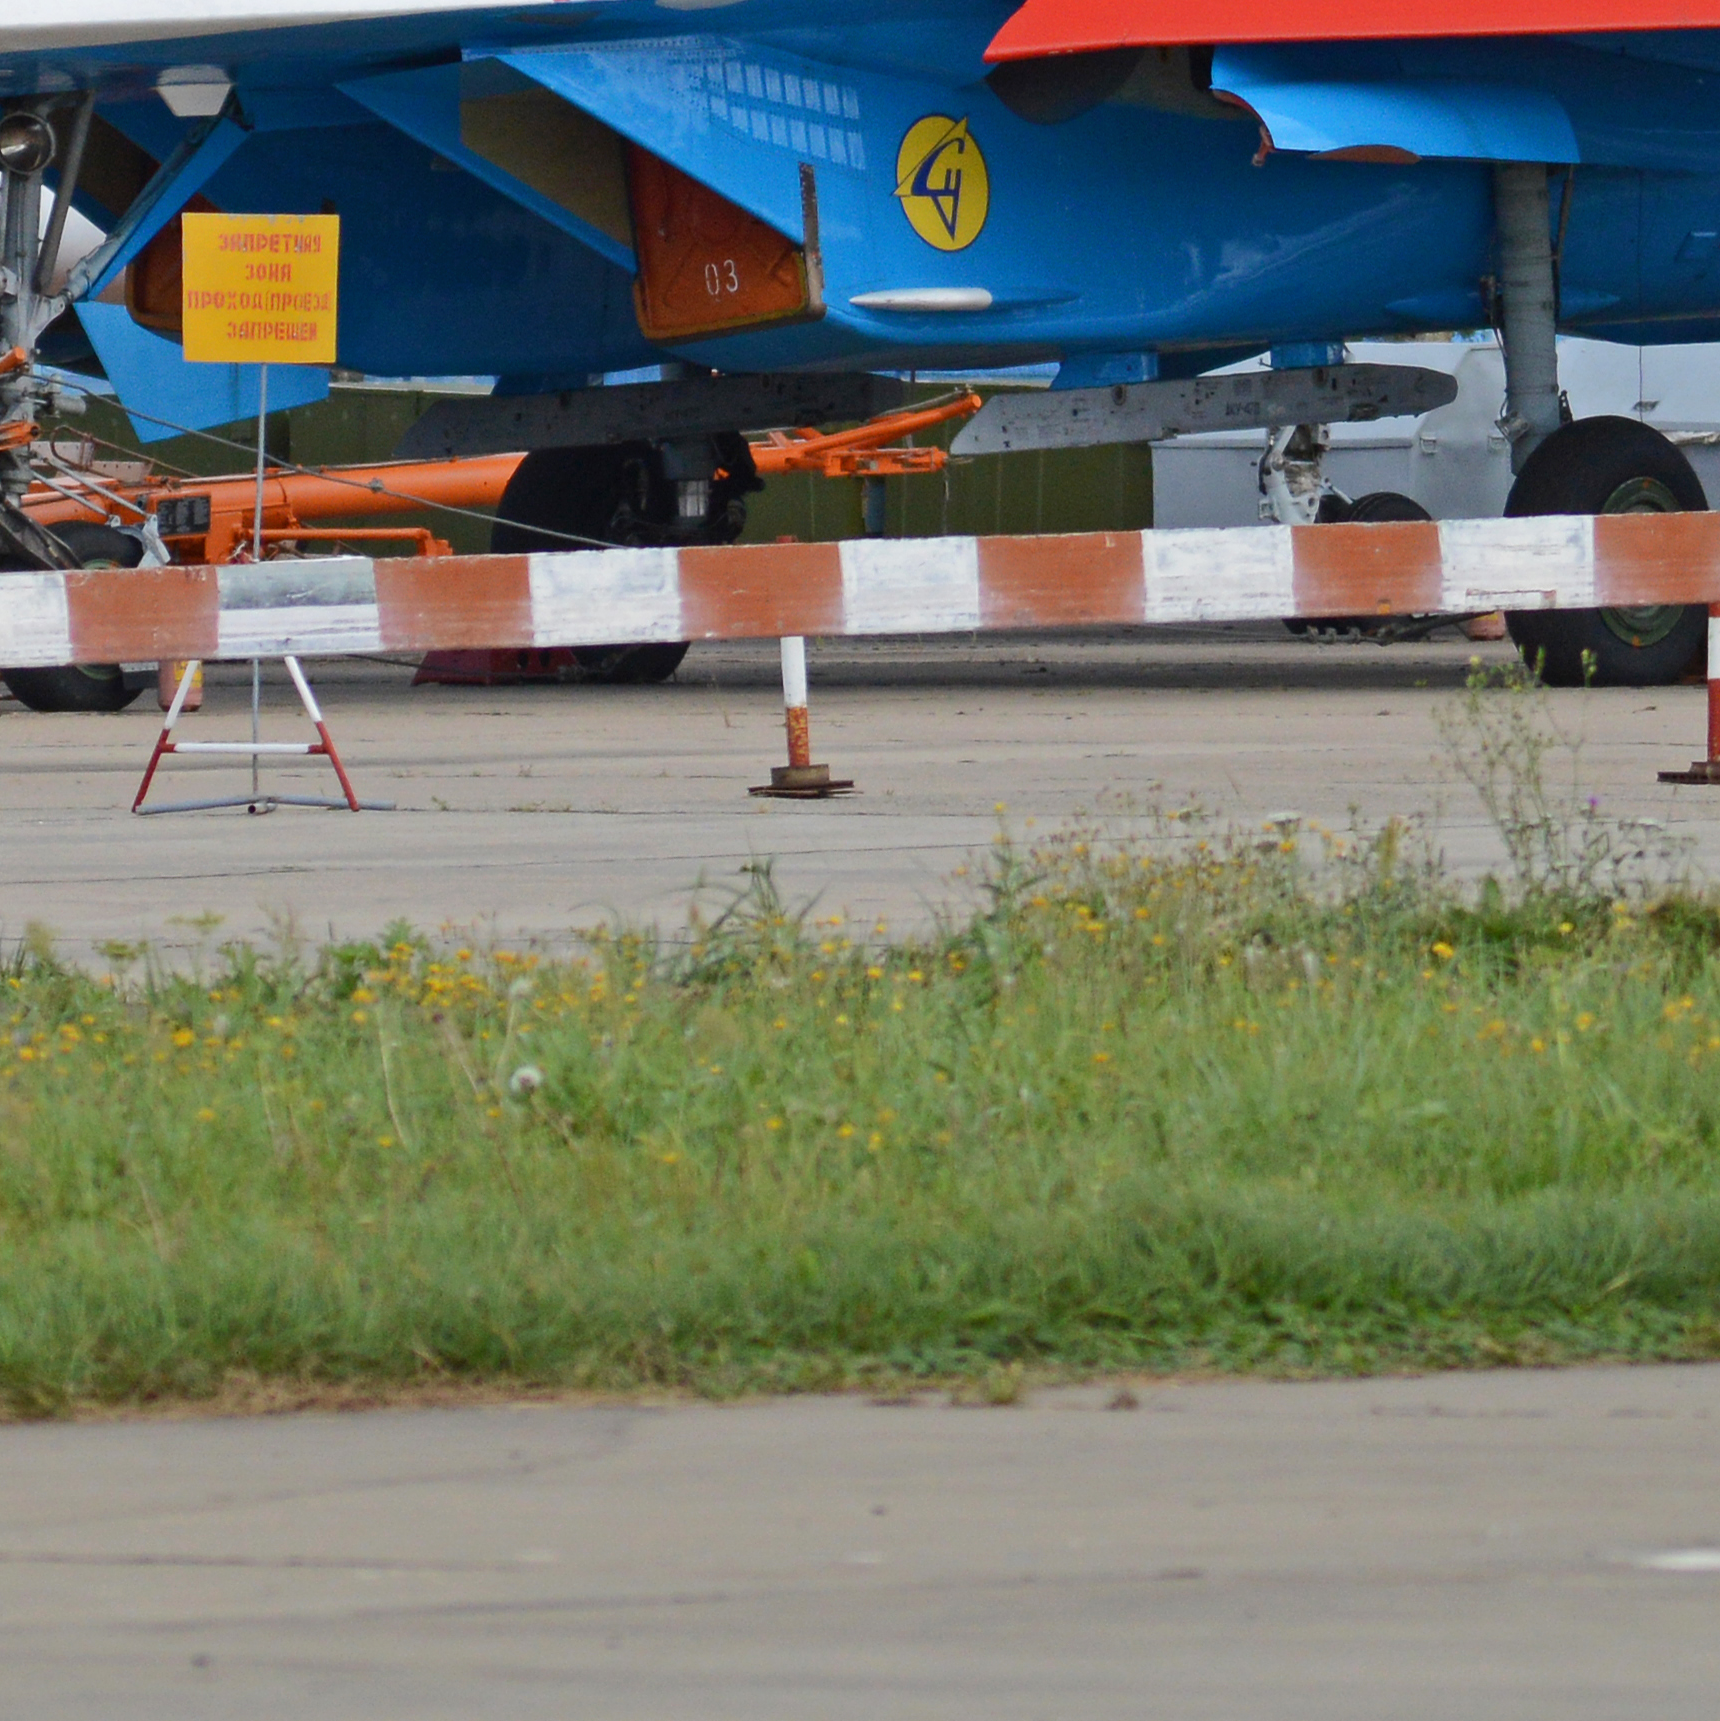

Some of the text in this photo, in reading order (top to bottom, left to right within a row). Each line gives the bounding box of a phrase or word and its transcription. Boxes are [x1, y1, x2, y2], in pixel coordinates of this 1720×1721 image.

[218, 232, 322, 254] ЗАПРЕТНАЯ
[244, 262, 292, 283] ЗОНА
[704, 259, 739, 295] 03
